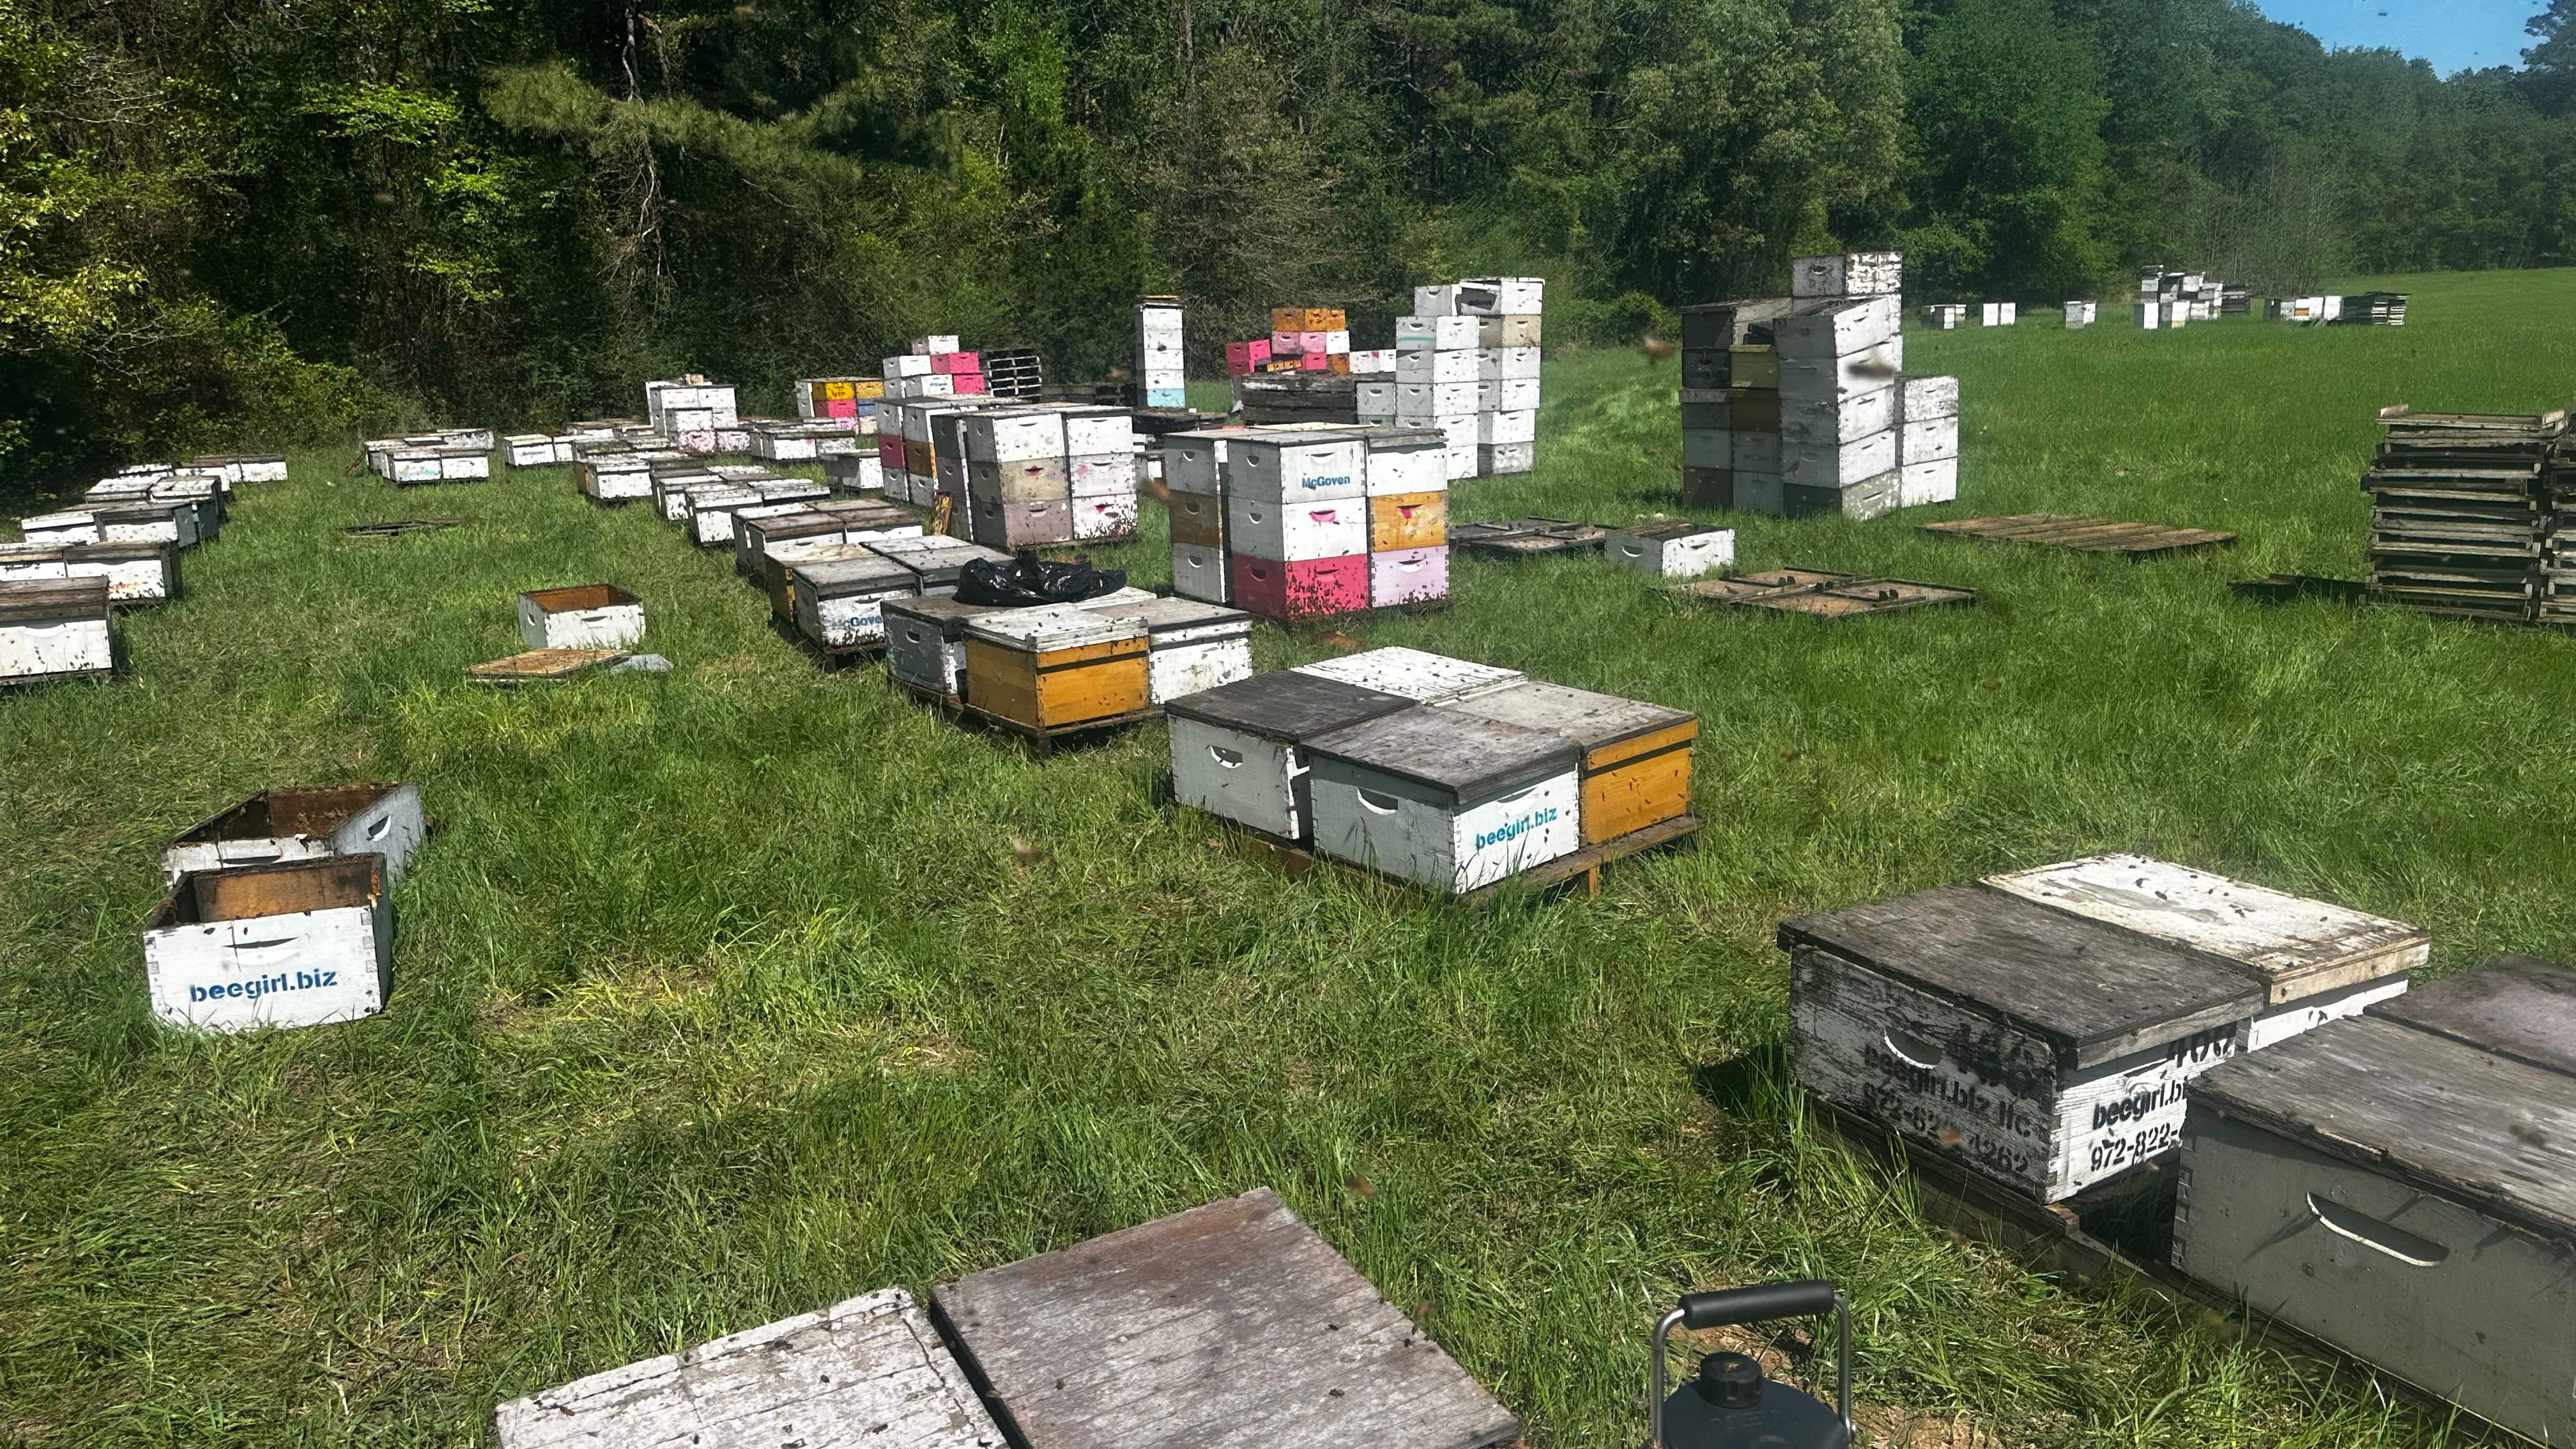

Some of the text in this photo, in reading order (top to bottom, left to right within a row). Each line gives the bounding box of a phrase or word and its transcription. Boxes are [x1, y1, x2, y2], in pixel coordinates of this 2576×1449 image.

[1302, 476, 1351, 488] McGoven
[1476, 807, 1558, 850] beegirl.biz
[190, 968, 338, 1002] beegirl.biz
[2092, 1075, 2188, 1130] beegirl.bi
